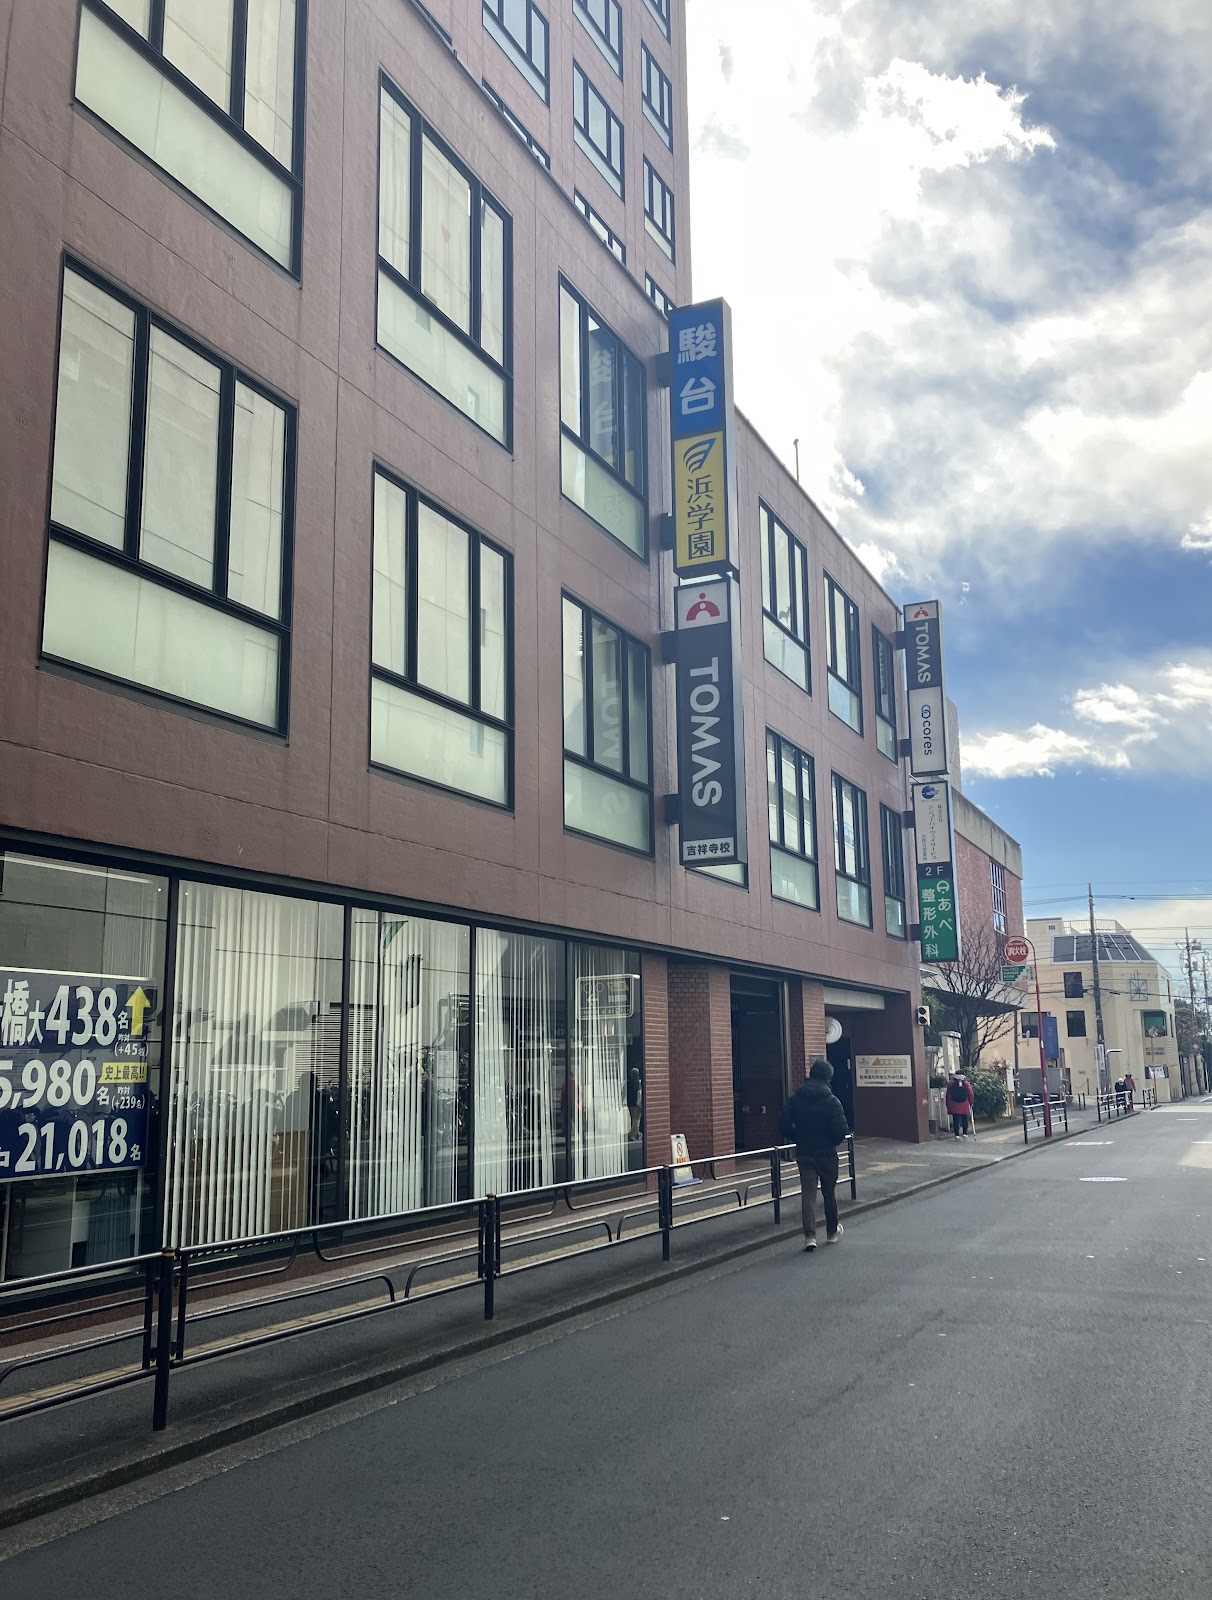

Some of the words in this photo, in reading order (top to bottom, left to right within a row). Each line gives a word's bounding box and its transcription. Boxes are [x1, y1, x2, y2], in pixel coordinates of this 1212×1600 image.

[677, 322, 717, 415] 駿台
[687, 474, 715, 560] 浜学園
[915, 622, 932, 684] TOMAS
[689, 656, 723, 807] TOMAS
[922, 720, 933, 756] cores
[686, 841, 731, 857] 吉祥寺校
[921, 888, 940, 958] 整形外科
[937, 897, 953, 931] あべ
